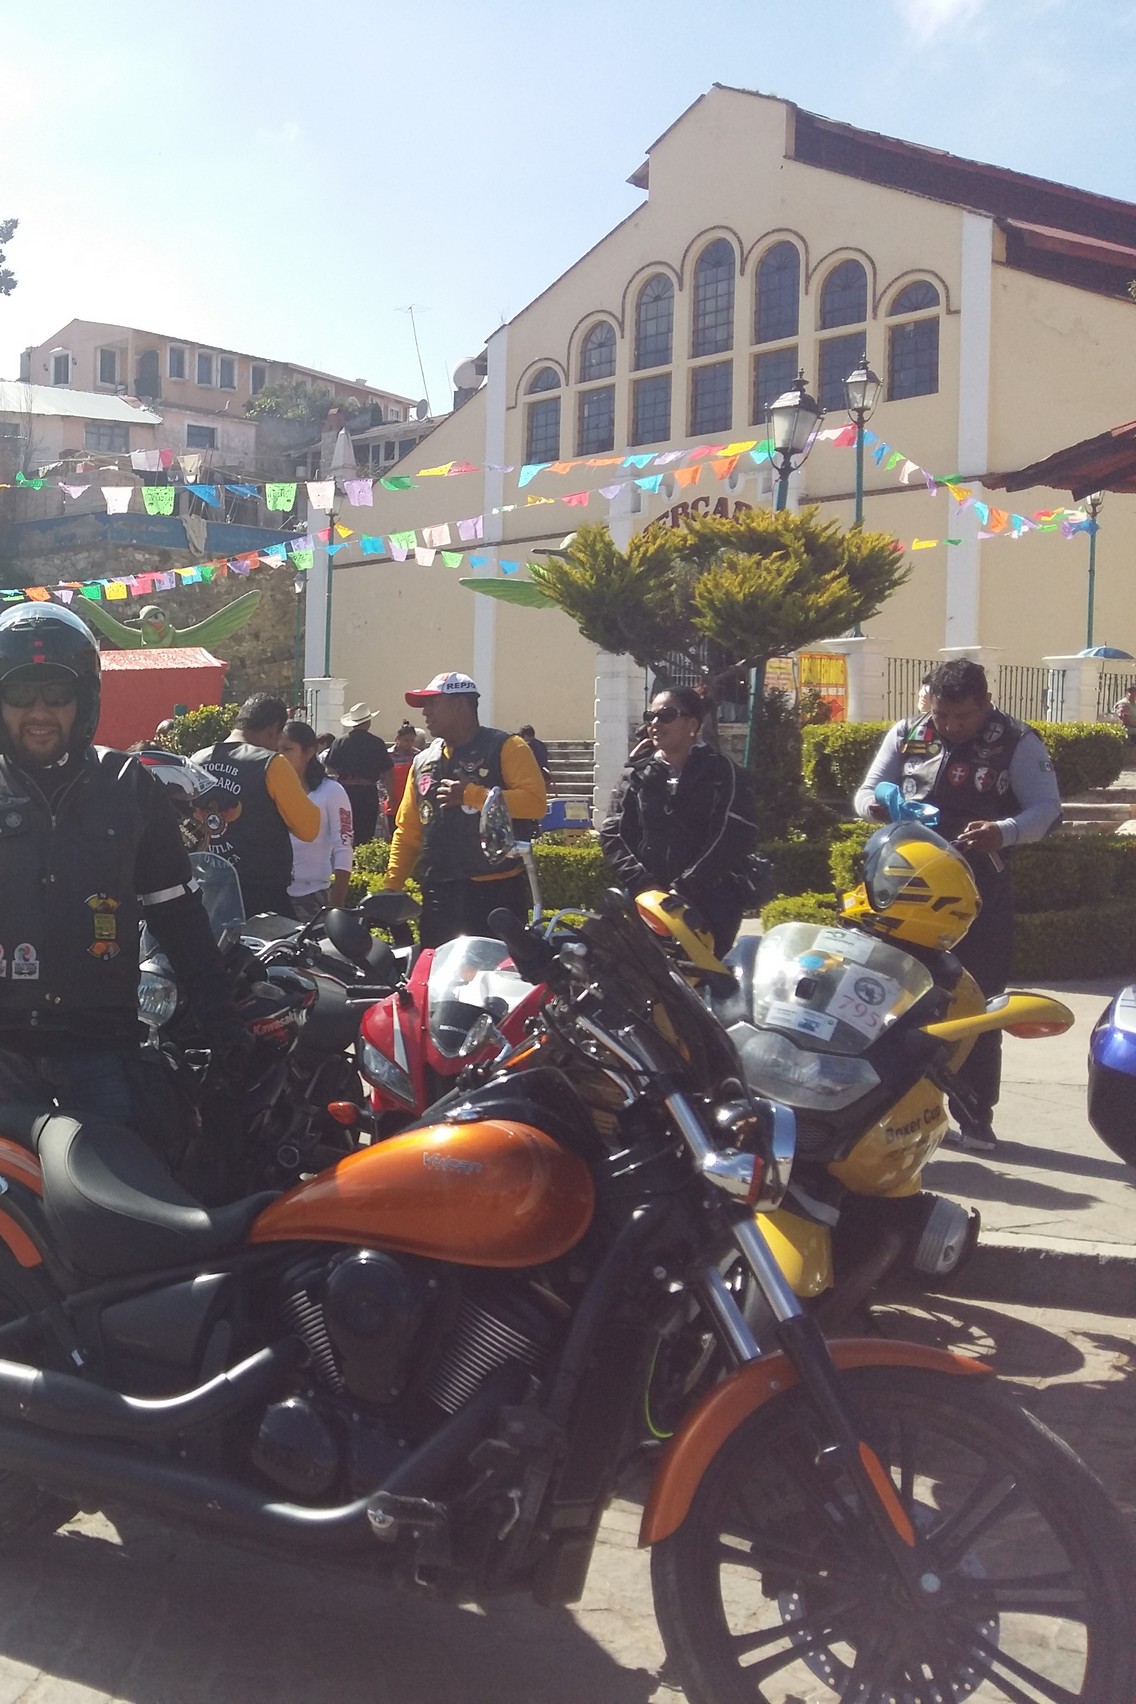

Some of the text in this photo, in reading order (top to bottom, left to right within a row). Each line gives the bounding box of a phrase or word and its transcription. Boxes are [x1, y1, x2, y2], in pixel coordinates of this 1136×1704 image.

[215, 777, 241, 795] ARIO
[838, 994, 882, 1029] 795
[885, 1117, 921, 1144] Boxer
